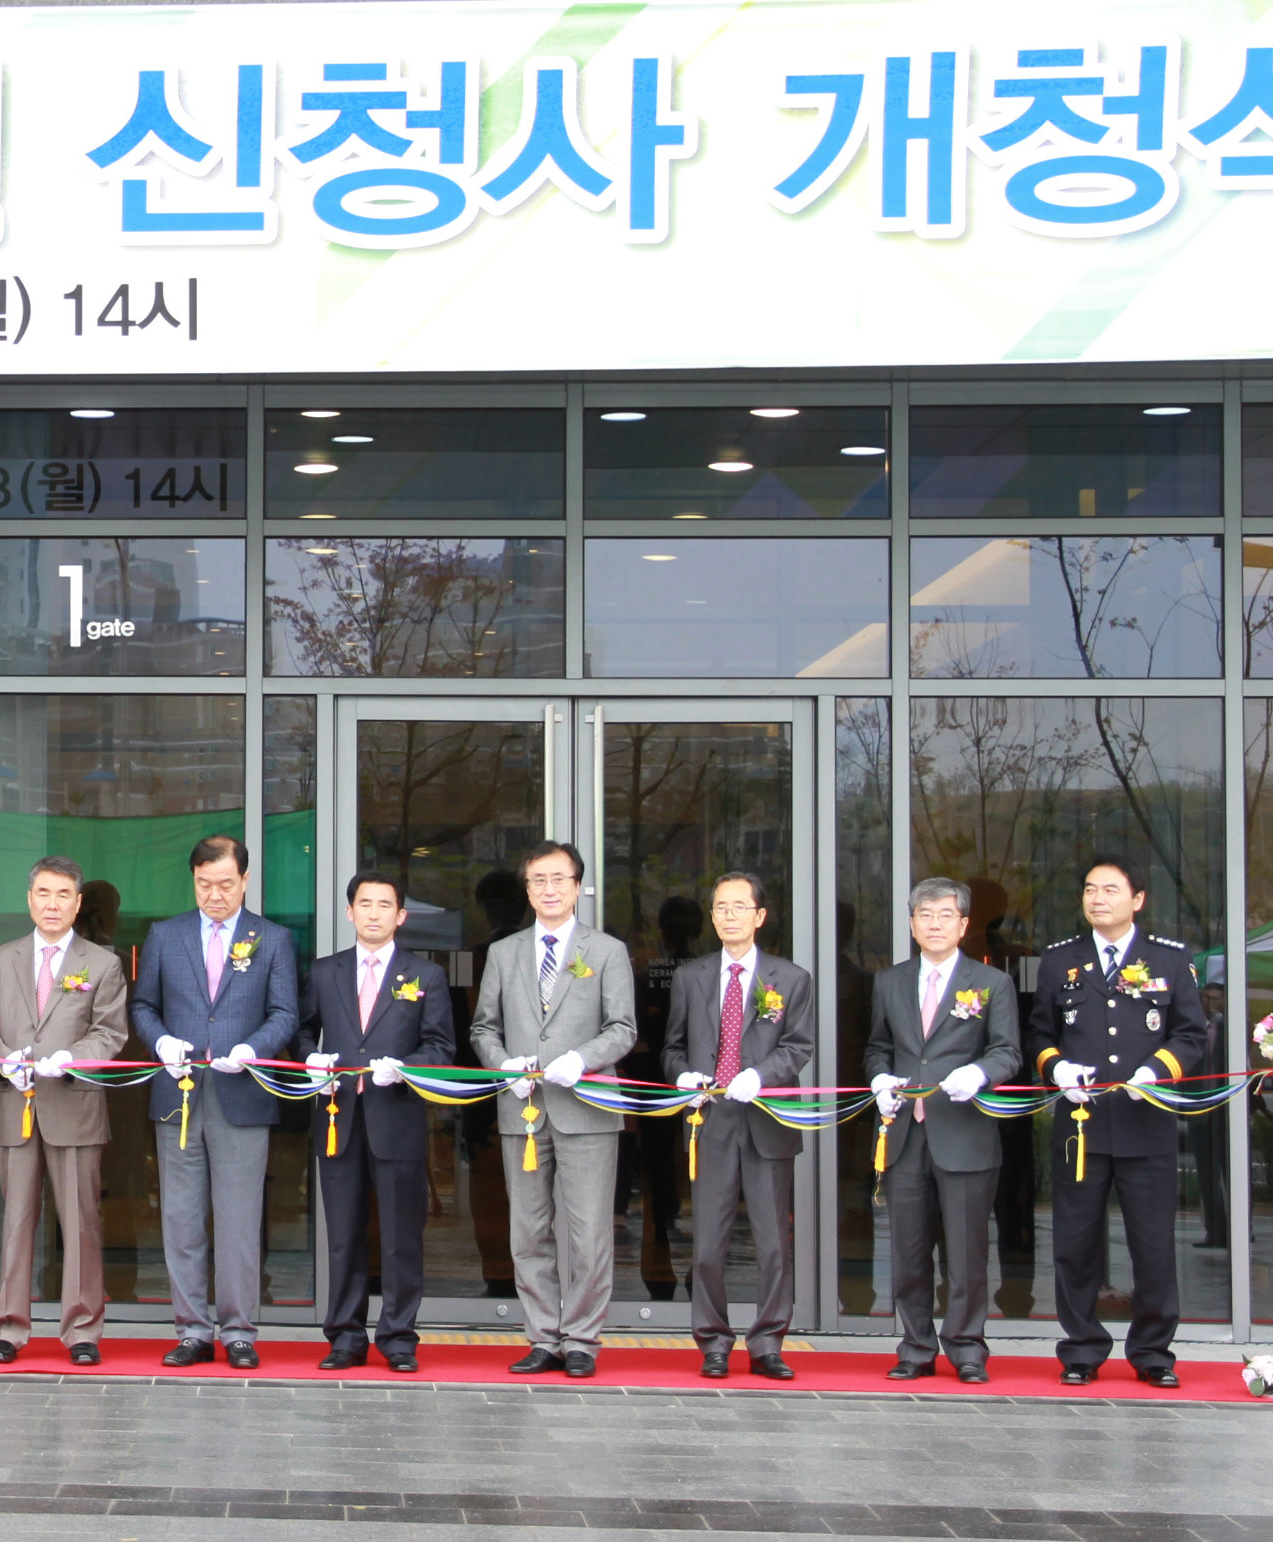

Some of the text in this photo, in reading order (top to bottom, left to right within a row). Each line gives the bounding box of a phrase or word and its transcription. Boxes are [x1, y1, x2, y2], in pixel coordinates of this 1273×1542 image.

[86, 58, 685, 236] 신청사
[63, 277, 199, 341] 14시
[124, 463, 229, 513] 14시
[58, 565, 135, 648] 1 gate
[648, 958, 676, 967] KOREA
